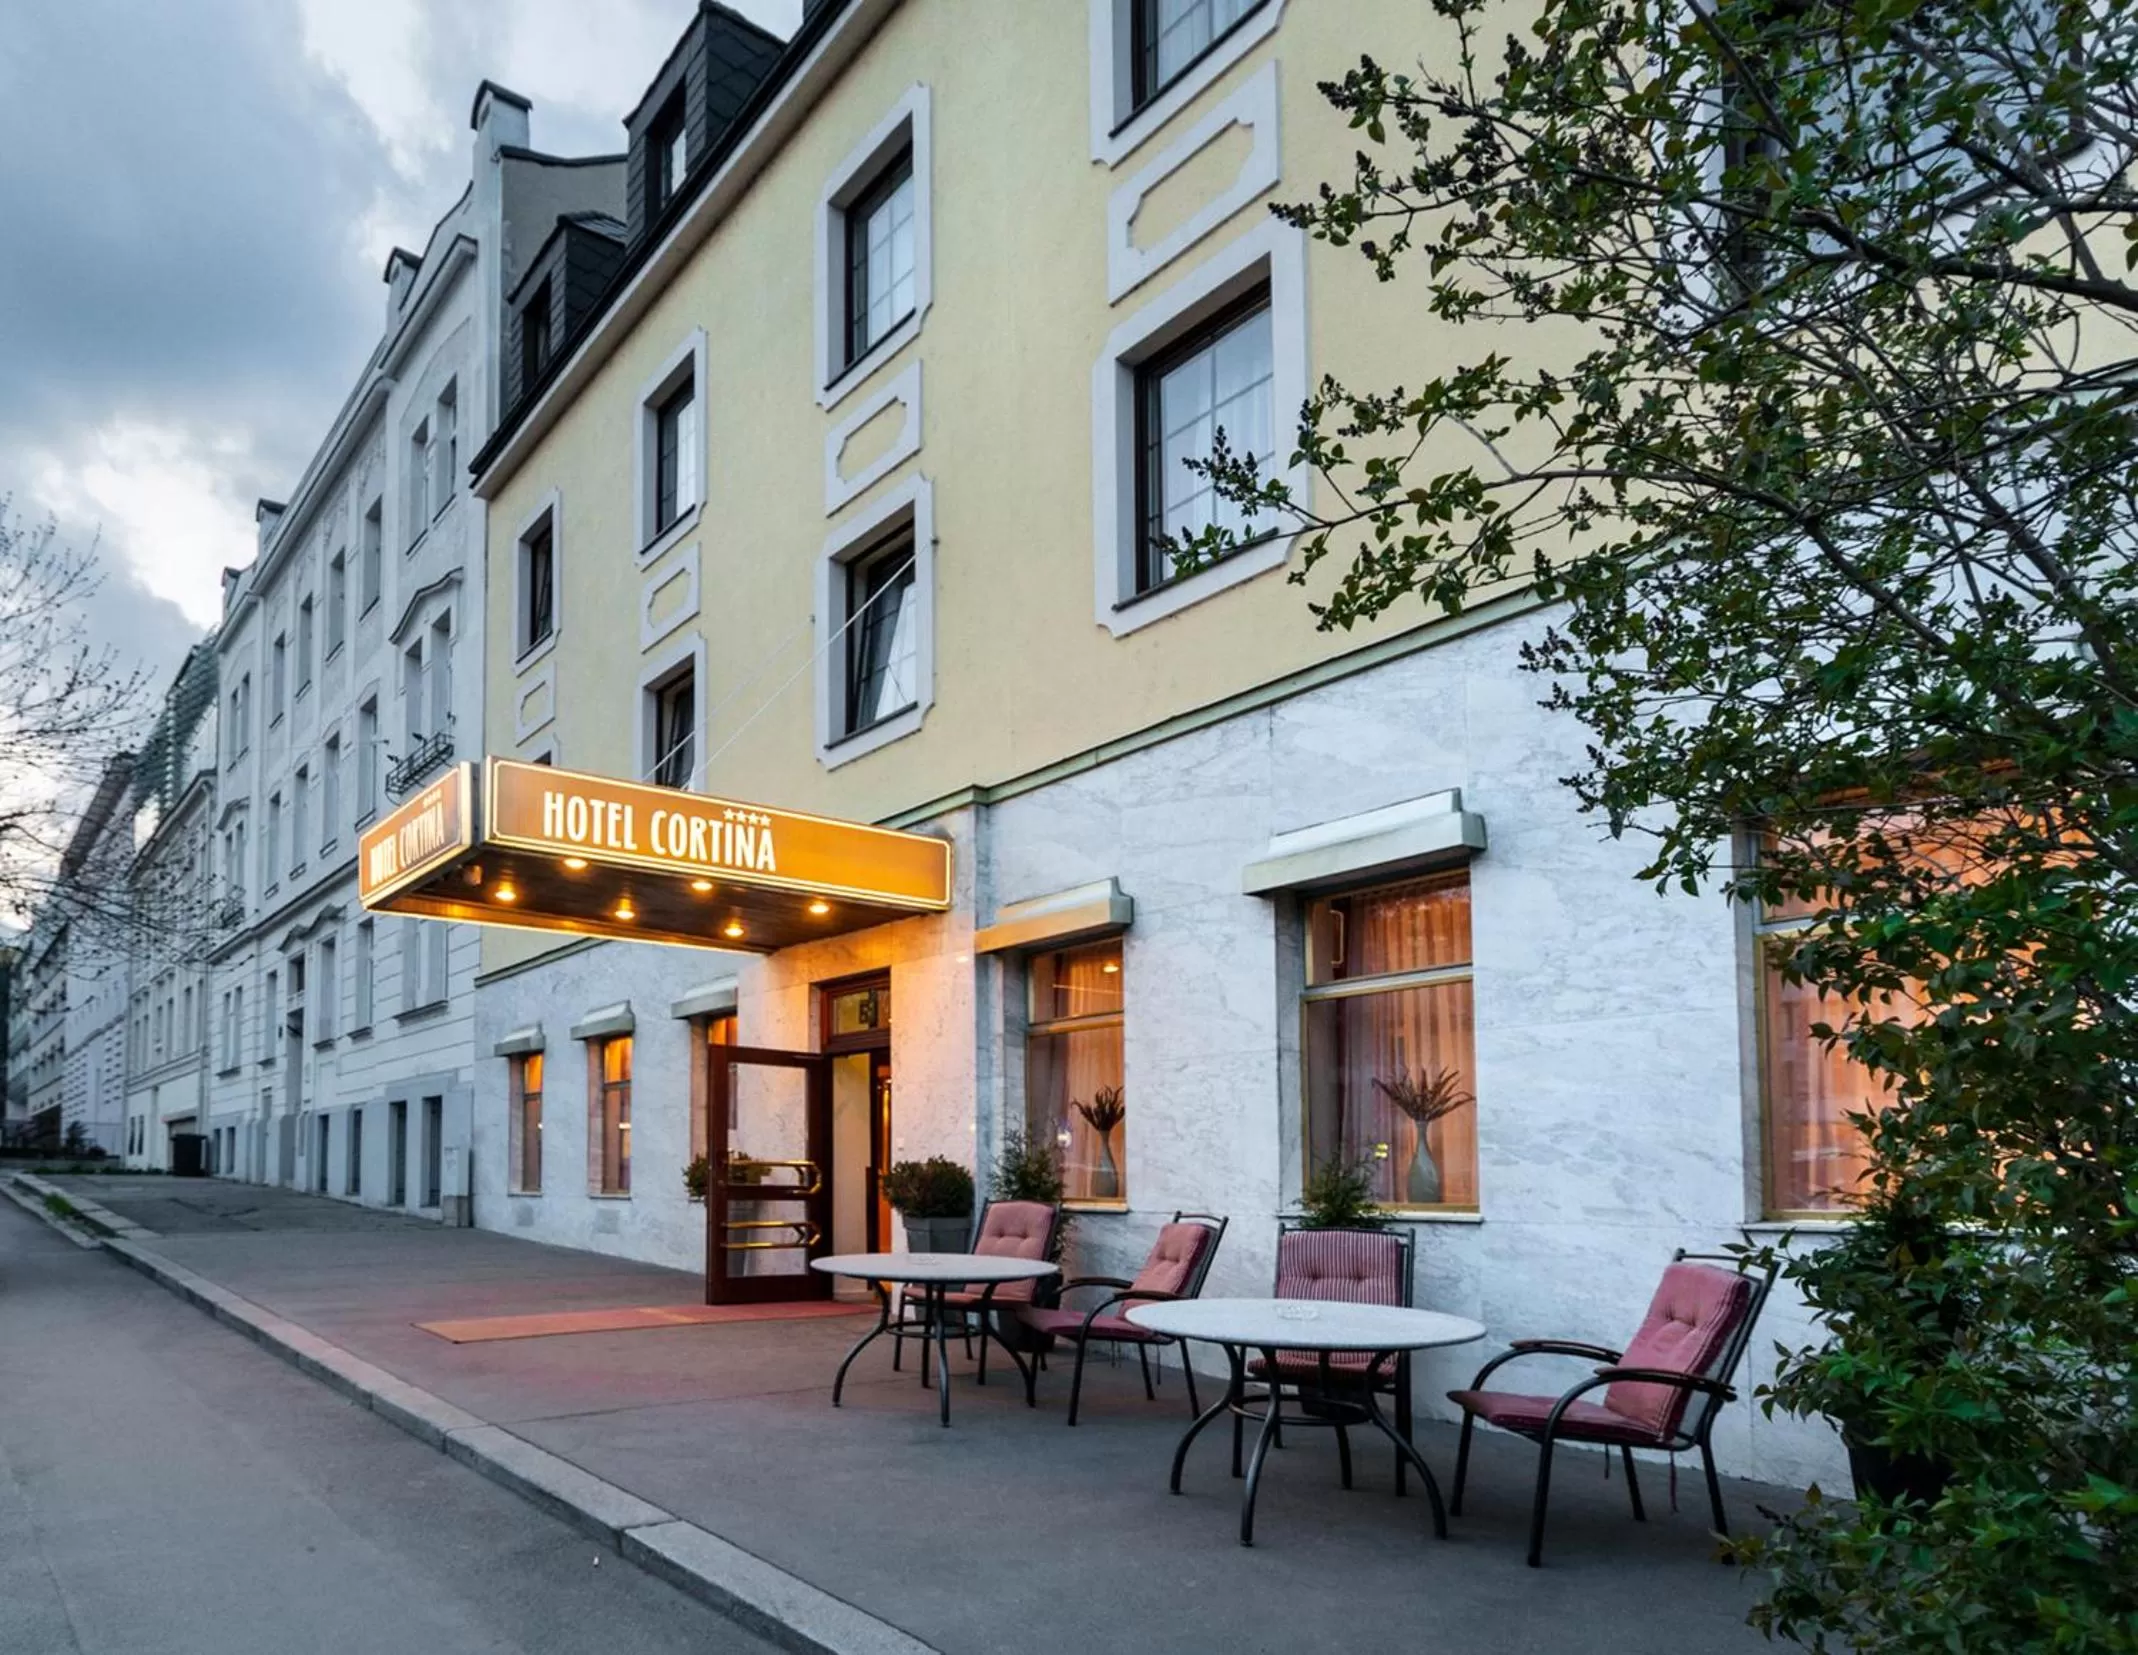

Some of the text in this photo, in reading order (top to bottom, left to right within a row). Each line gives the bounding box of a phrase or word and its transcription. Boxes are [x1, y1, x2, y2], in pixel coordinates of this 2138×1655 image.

[370, 800, 445, 887] HOTEL CORTINA
[543, 791, 777, 872] HOTEL CORTINA
